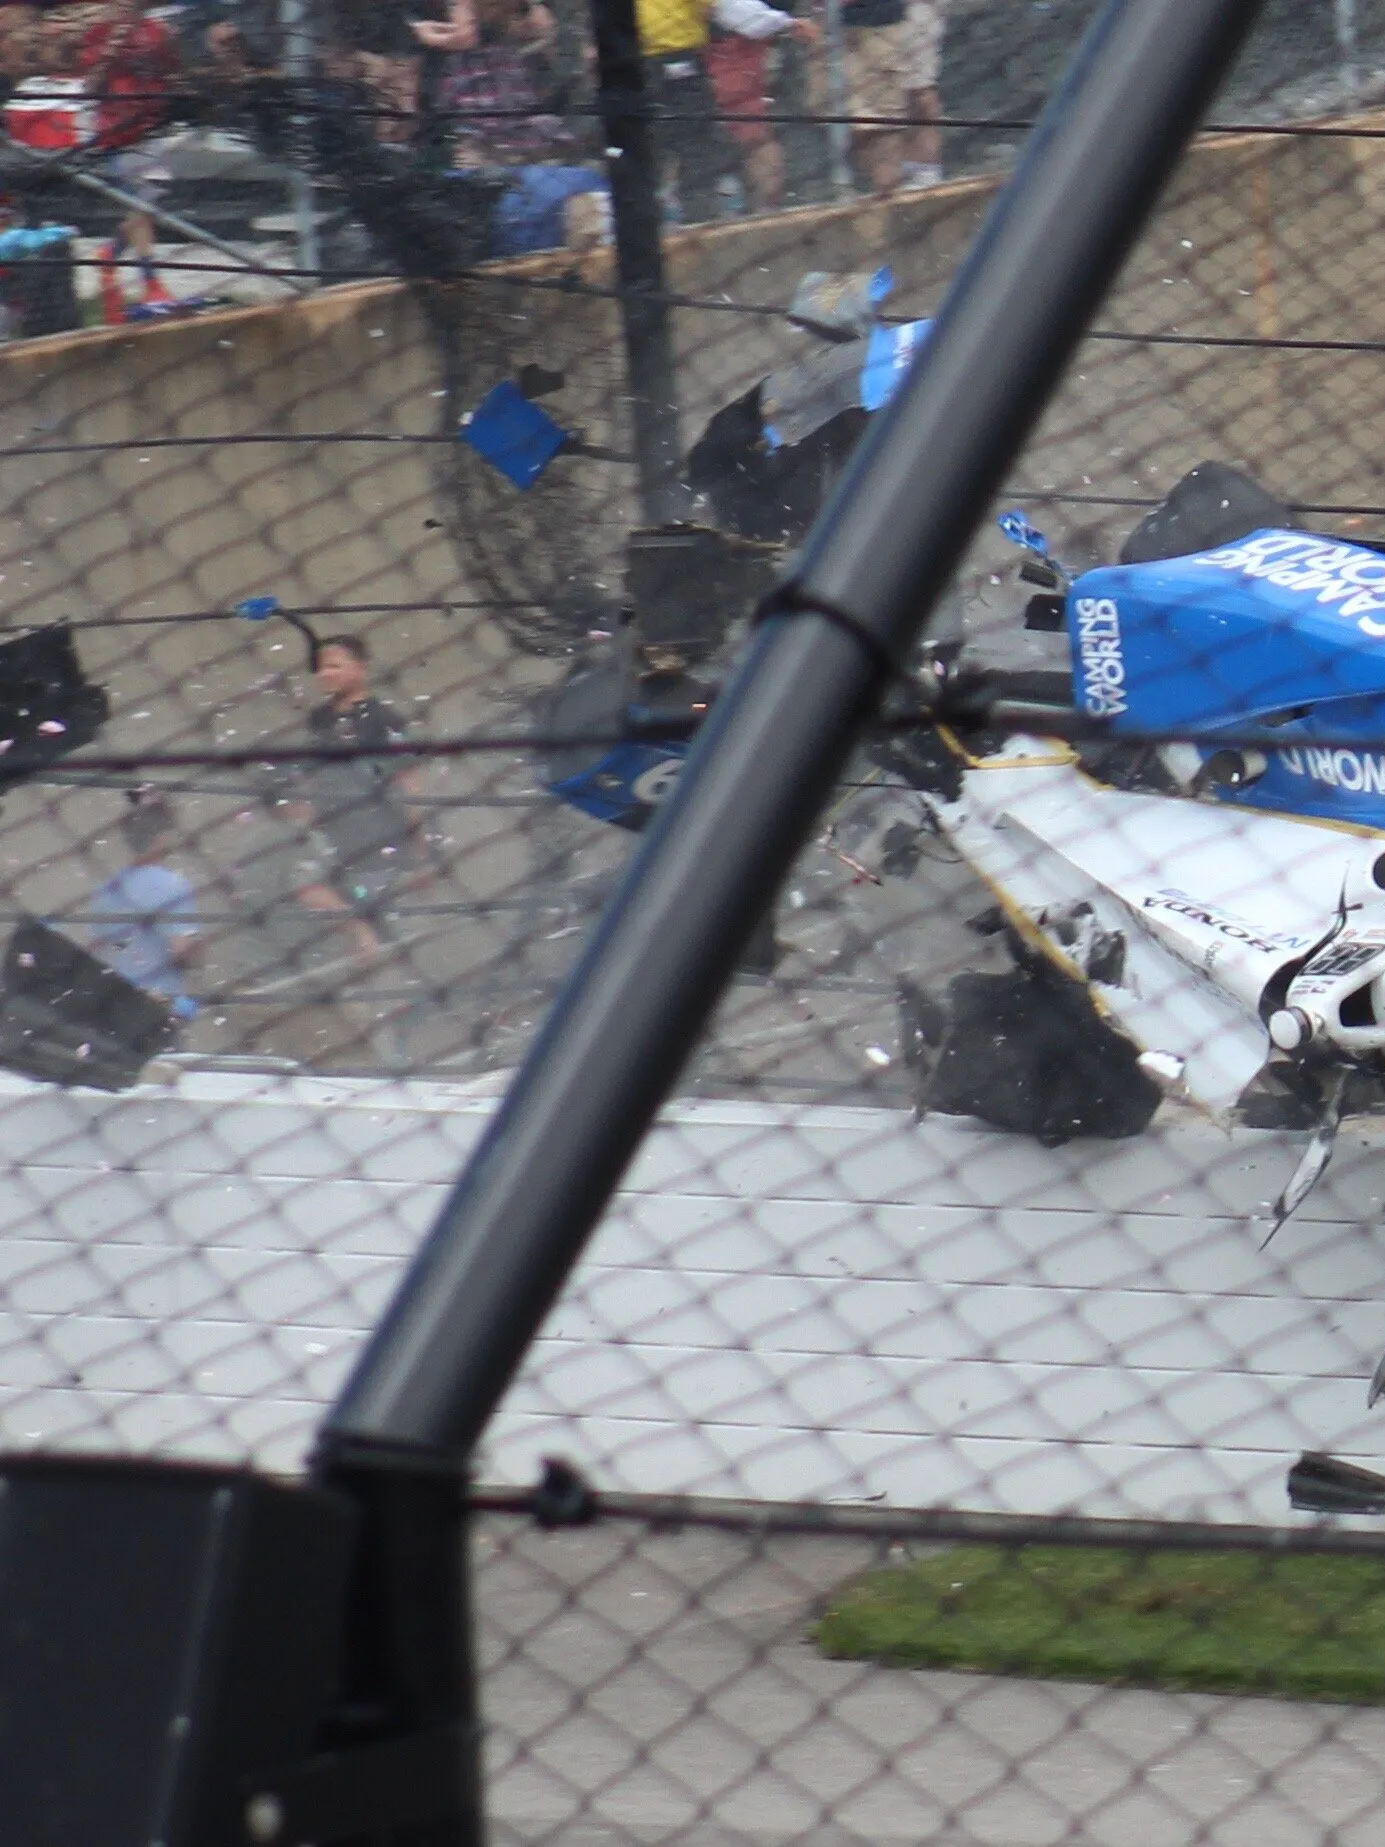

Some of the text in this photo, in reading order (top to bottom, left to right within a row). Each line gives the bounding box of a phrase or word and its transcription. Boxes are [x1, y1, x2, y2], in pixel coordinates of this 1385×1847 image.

[1075, 597, 1108, 719] CAMPING
[1096, 598, 1129, 718] WORLD
[1142, 897, 1281, 953] HONDA
